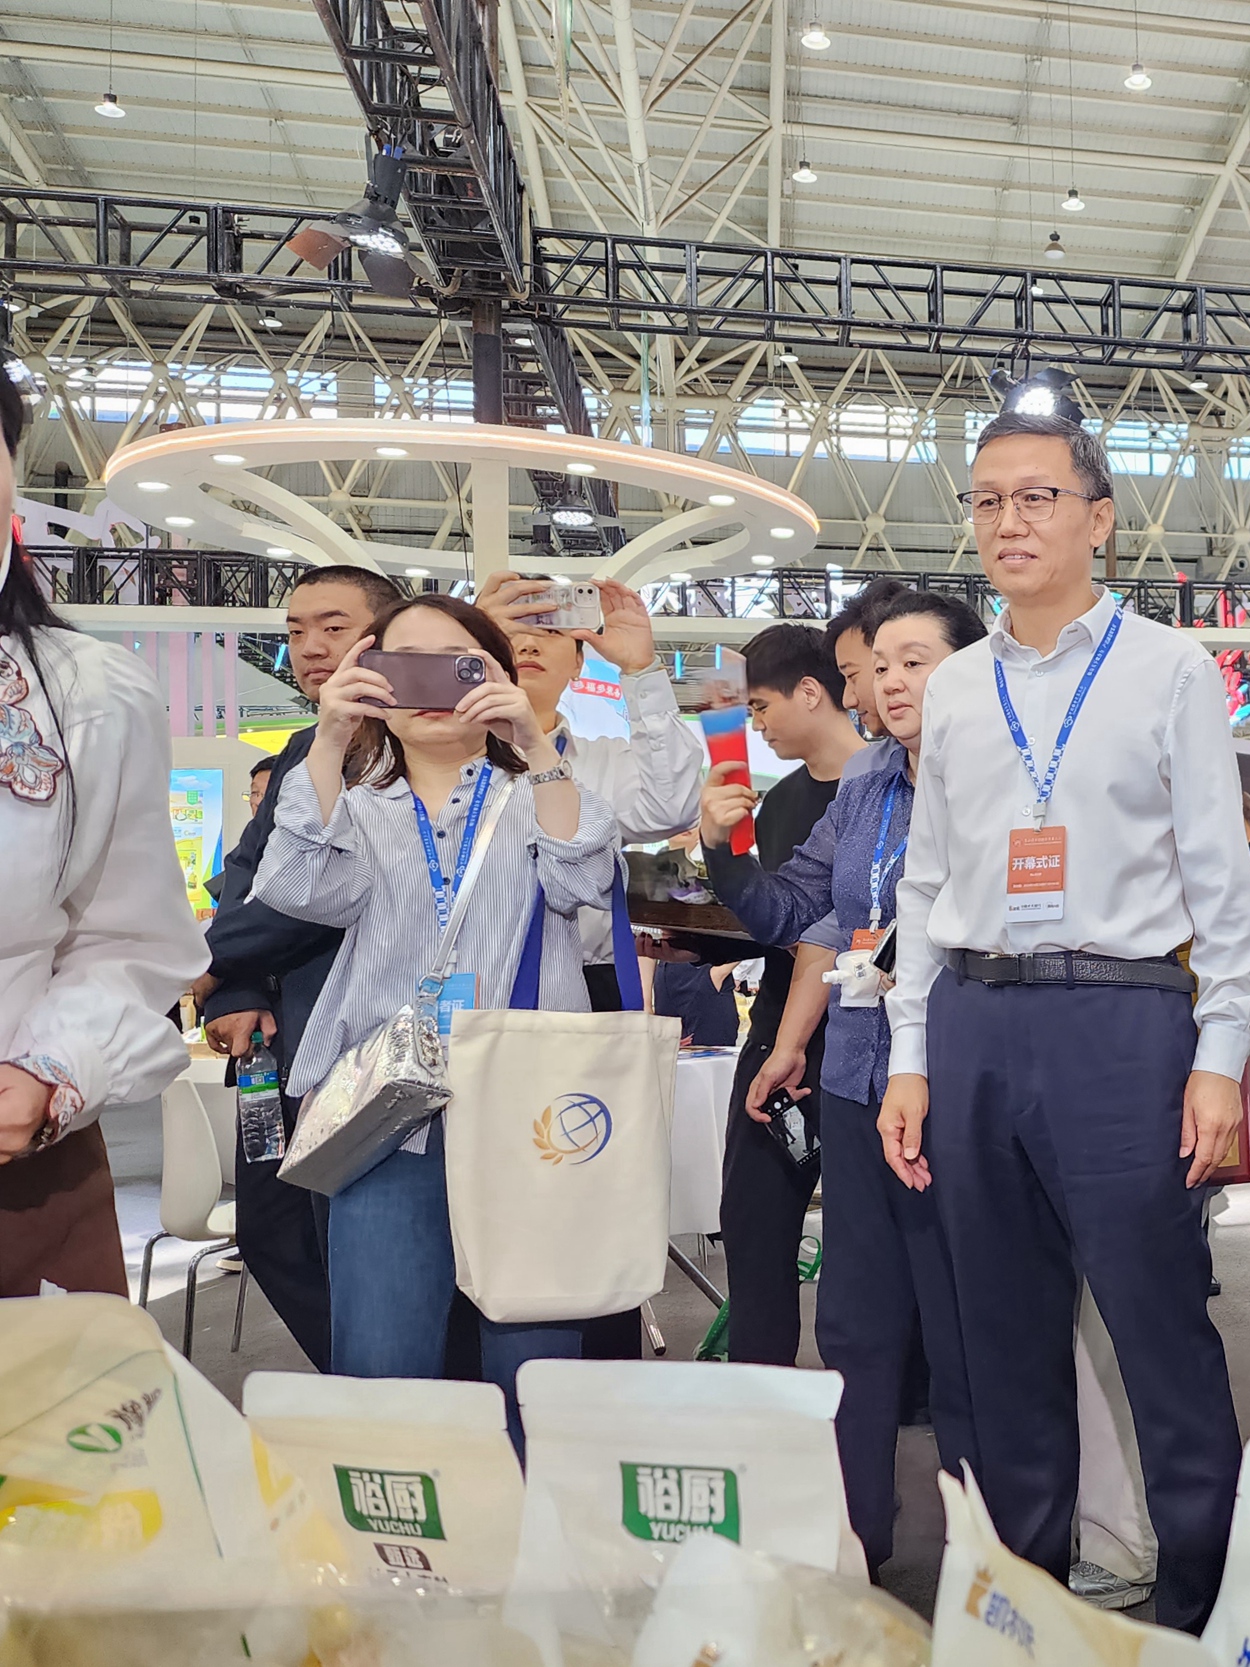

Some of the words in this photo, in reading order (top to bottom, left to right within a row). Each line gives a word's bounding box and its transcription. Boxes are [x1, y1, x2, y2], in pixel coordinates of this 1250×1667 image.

[1011, 854, 1061, 871] 开幕式证
[439, 999, 465, 1013] 者证
[366, 1518, 423, 1537] YUCHU
